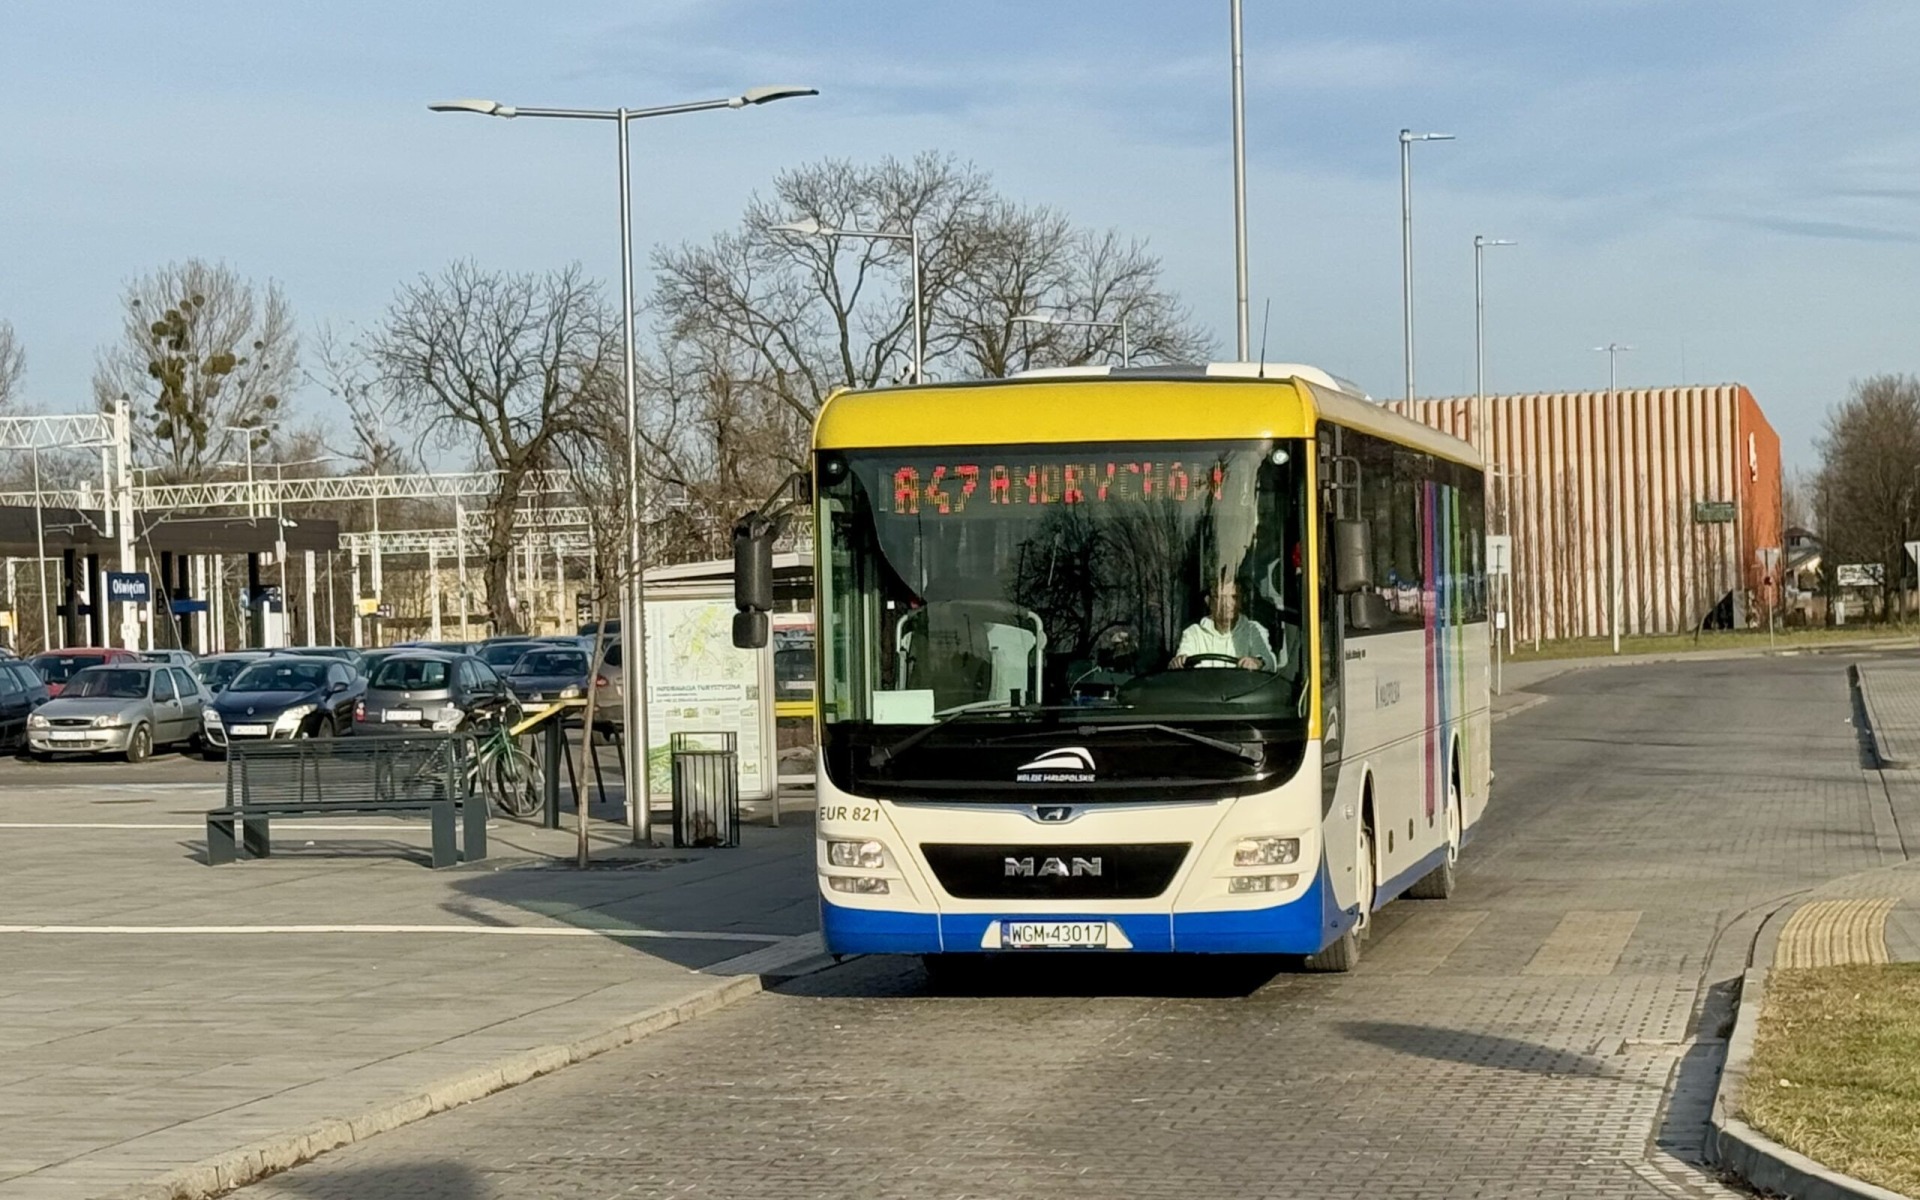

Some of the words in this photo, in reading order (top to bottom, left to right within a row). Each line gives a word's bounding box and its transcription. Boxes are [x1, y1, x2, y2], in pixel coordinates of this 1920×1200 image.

[893, 464, 980, 515] A47
[820, 806, 848, 822] EUR
[852, 806, 880, 823] 821
[1004, 856, 1102, 877] MAN
